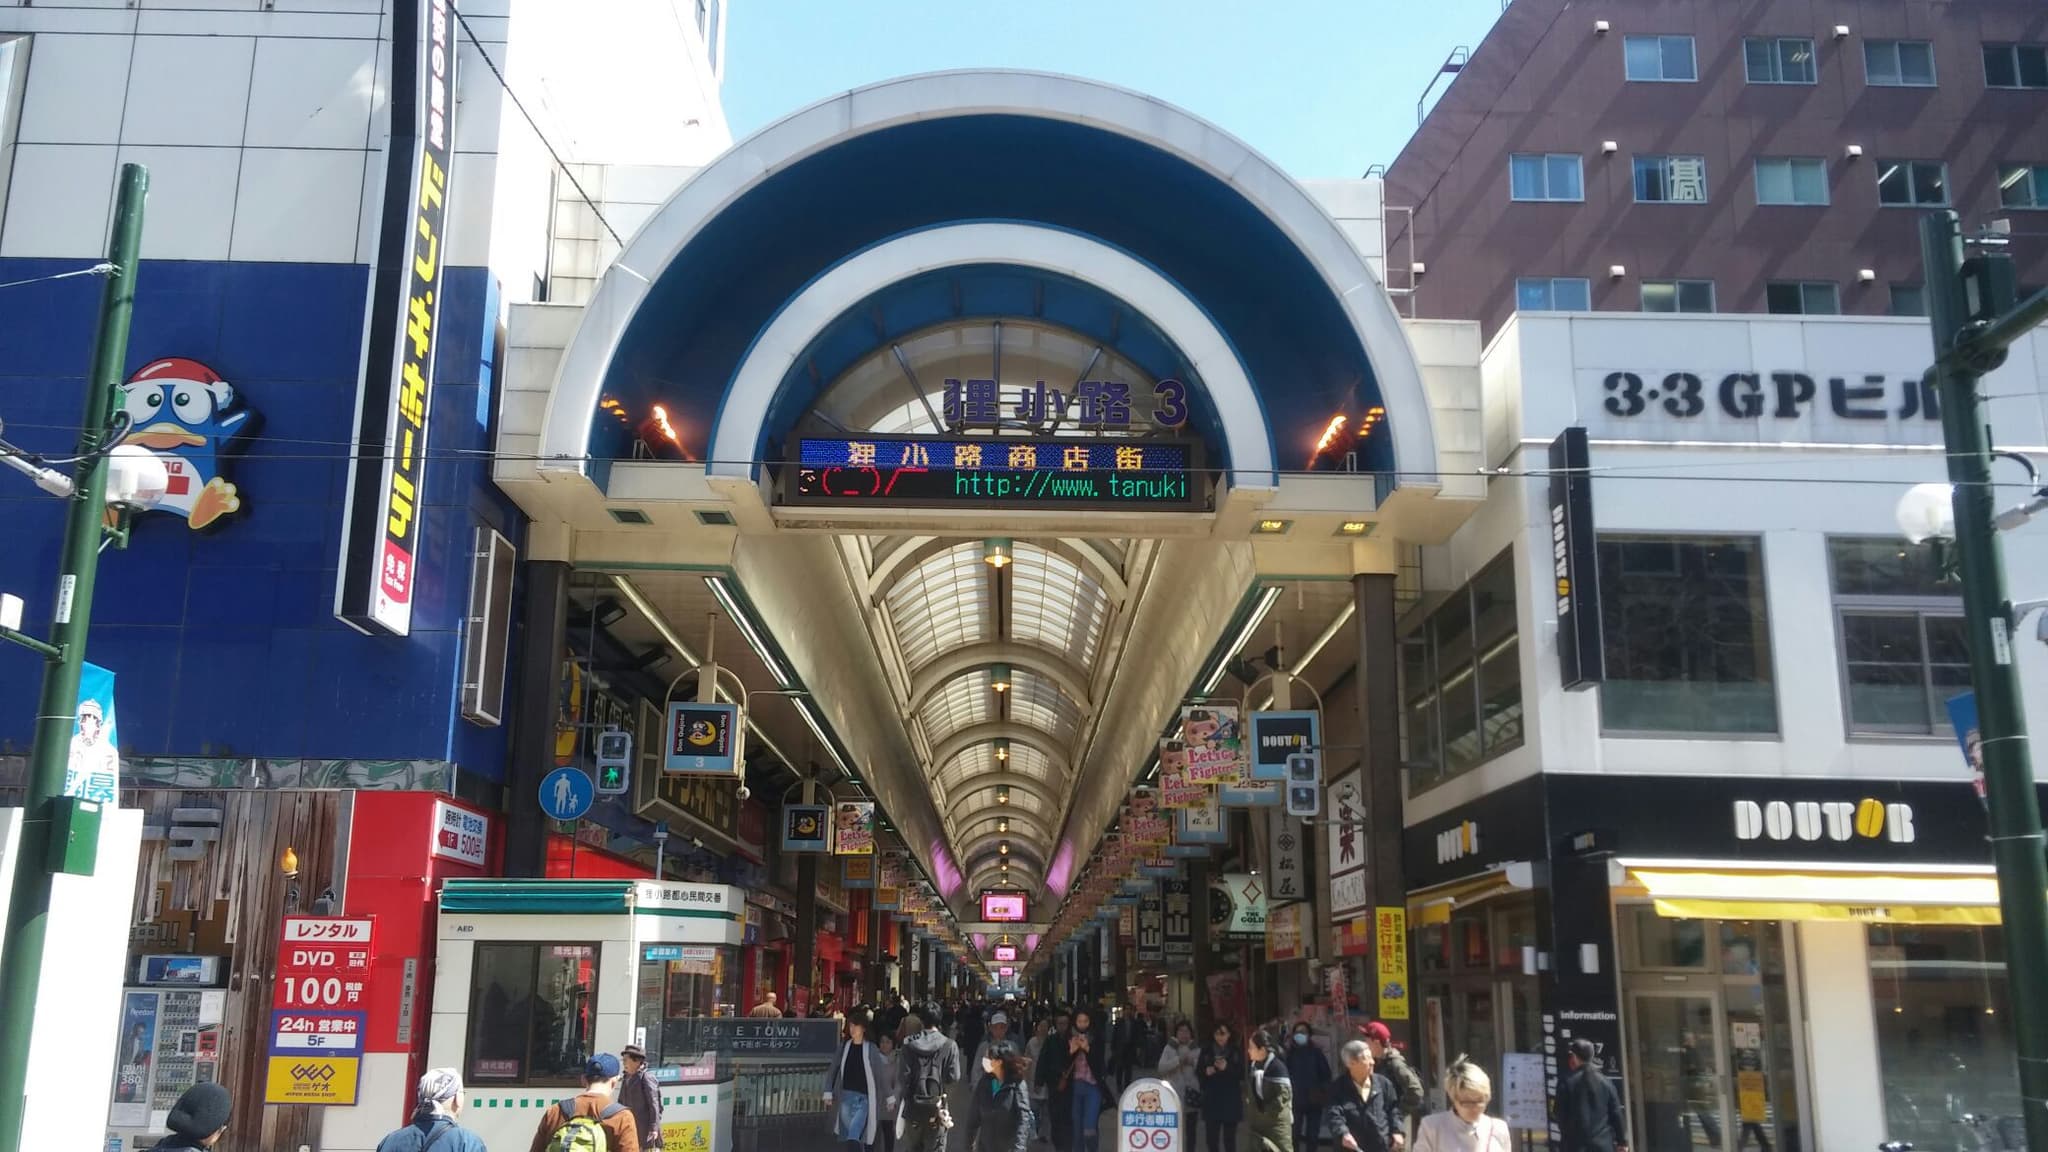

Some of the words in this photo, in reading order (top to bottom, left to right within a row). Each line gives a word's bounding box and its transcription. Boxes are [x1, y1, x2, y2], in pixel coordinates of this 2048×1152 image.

[943, 378, 1131, 427] 狸小路
[1152, 379, 1189, 428] 3
[847, 441, 1144, 472] 狸小路商店街
[1734, 797, 1916, 844] DOUTOR
[297, 923, 359, 939] レンタル
[457, 925, 475, 933] AED
[292, 951, 335, 967] DVD
[283, 978, 341, 1005] 100
[347, 991, 359, 1002] 円
[280, 1018, 315, 1033] 24h
[318, 1019, 357, 1034] 営業中
[753, 1026, 801, 1037] TOWN
[307, 1035, 326, 1047] 5F
[120, 1074, 142, 1085] 380
[290, 1063, 336, 1081] GEO
[311, 1082, 331, 1092] ゲオ
[1124, 1112, 1176, 1126] 歩行者専用
